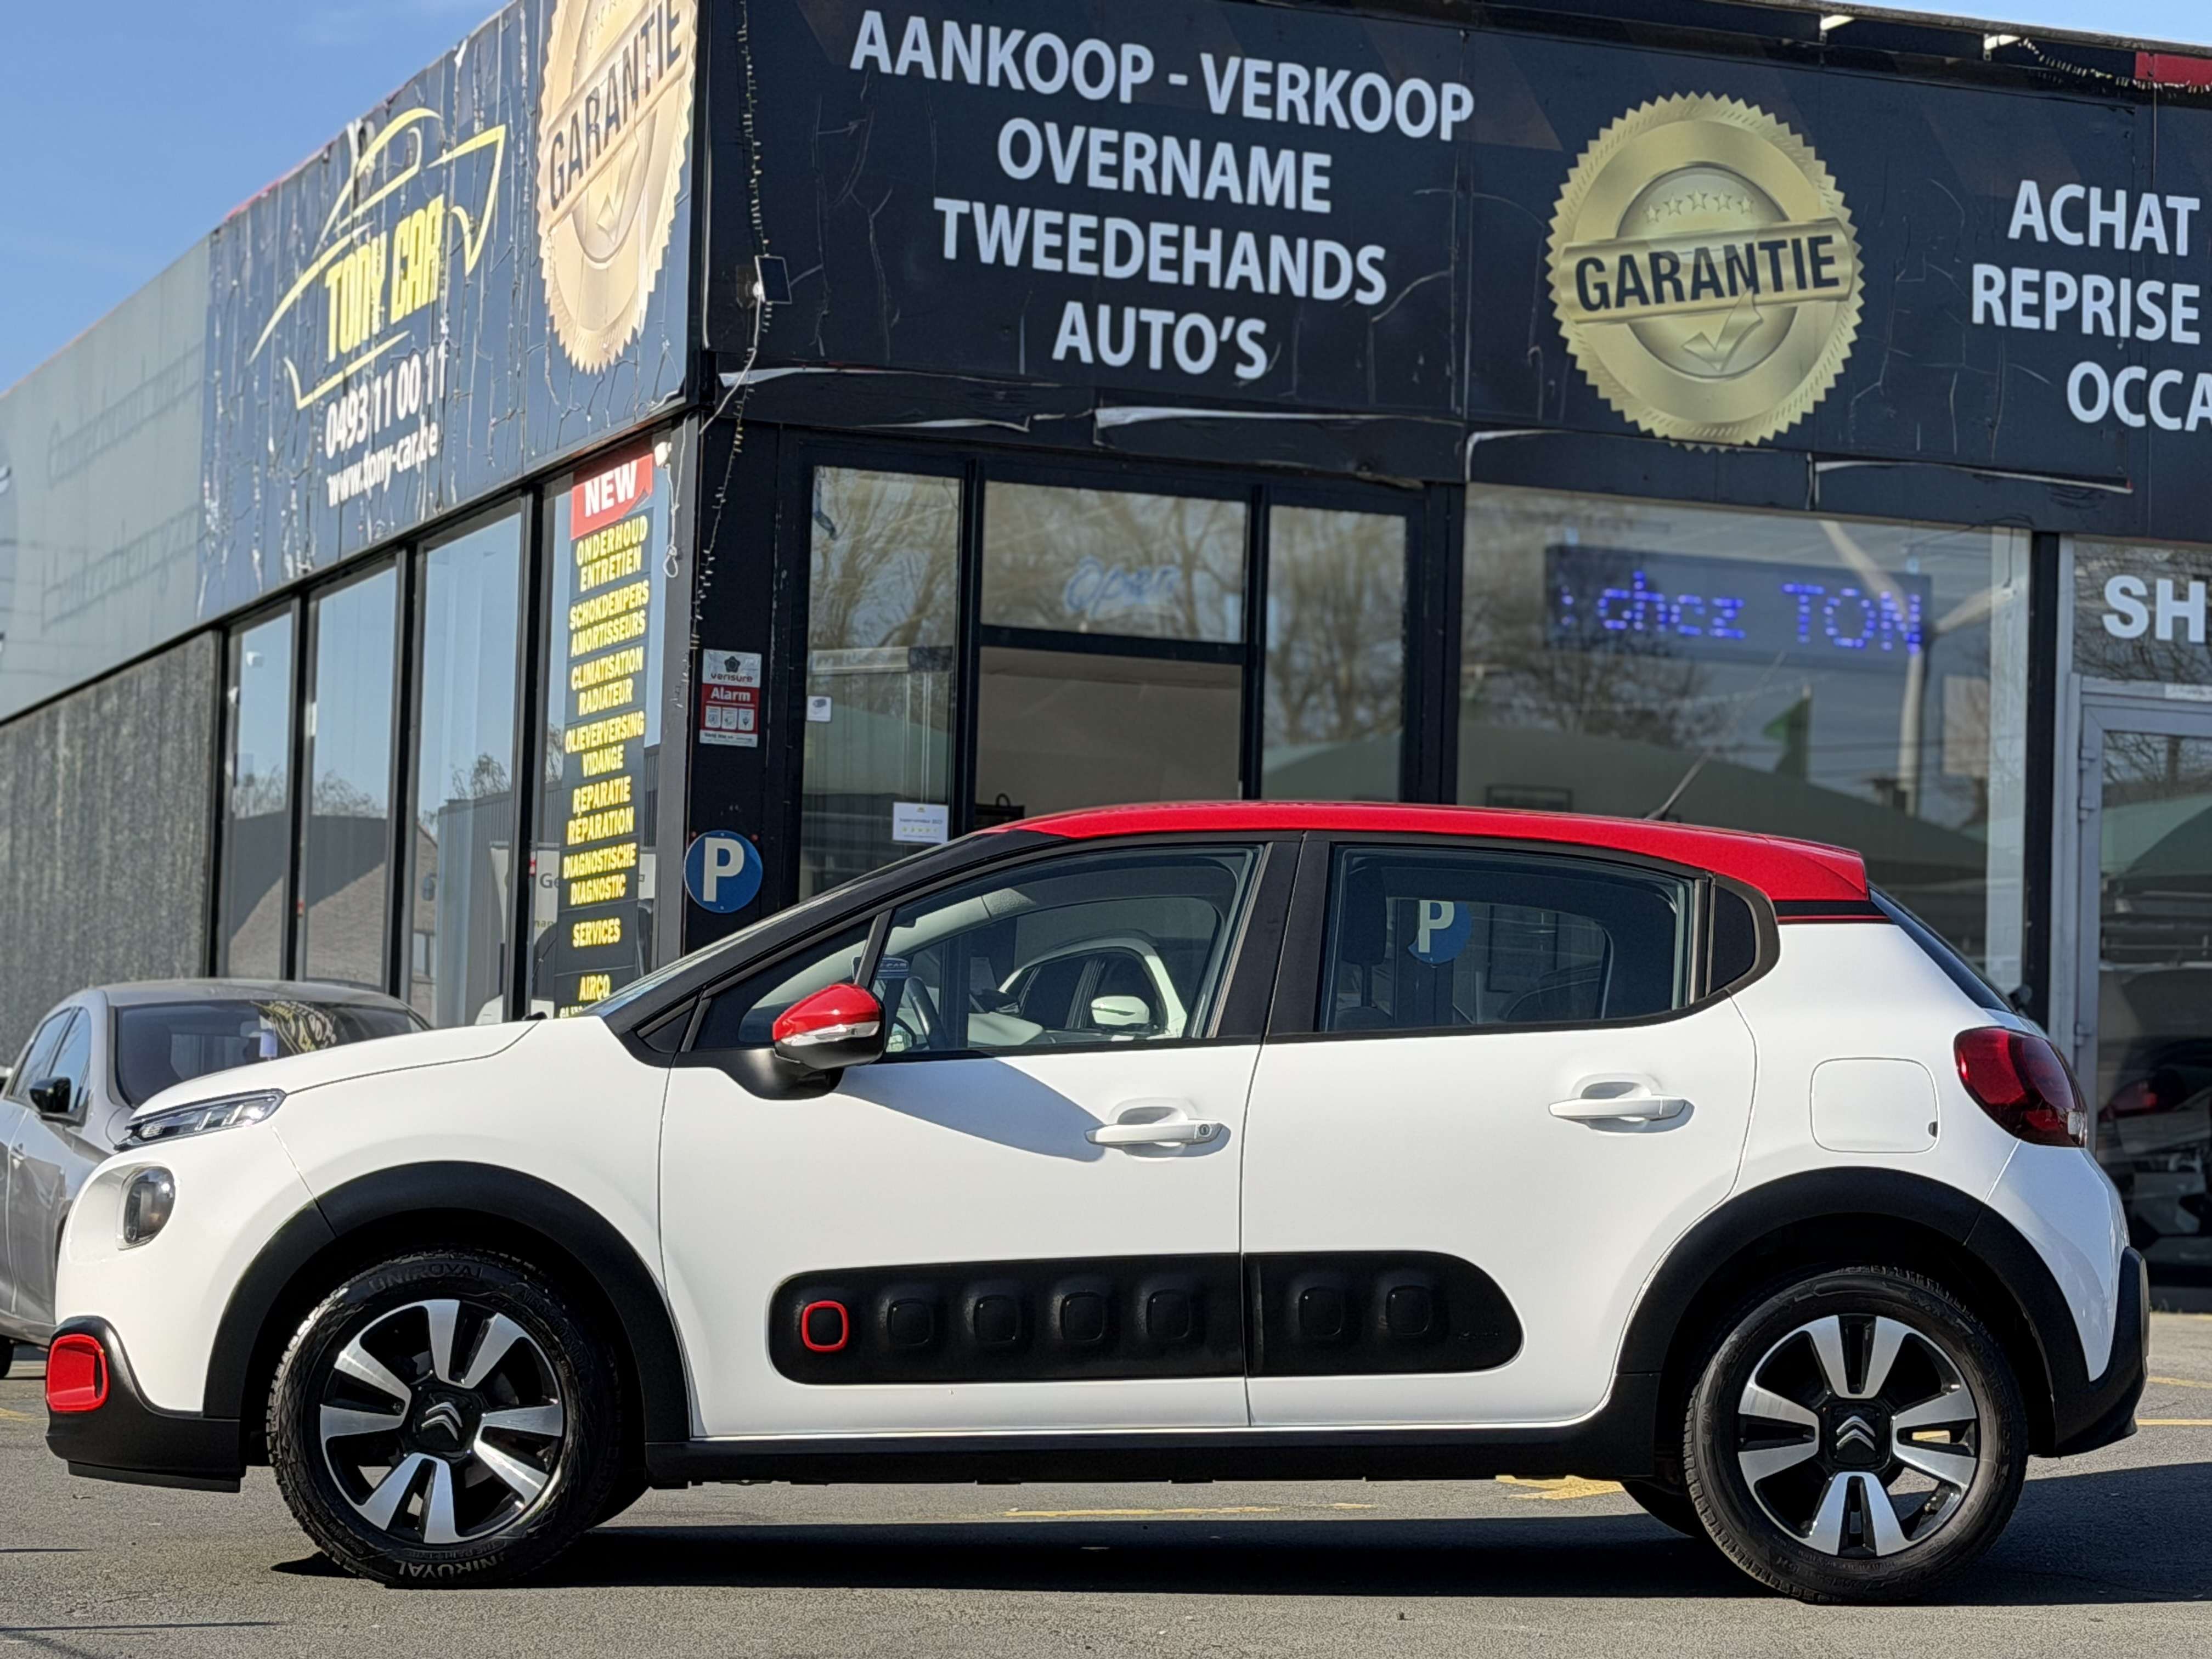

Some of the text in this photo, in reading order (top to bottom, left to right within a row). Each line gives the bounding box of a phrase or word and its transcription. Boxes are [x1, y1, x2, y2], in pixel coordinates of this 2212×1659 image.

[851, 10, 1474, 141] AANKOOP - VERKOOP
[550, 0, 682, 211] GARANTIE
[998, 118, 1331, 213] OVERNAME
[2007, 180, 2200, 257] ACHAT
[325, 194, 444, 363] TONY CAR
[934, 198, 1387, 305] TWEEDEHANDS
[1575, 235, 1839, 312] GARANTIE
[1973, 263, 2200, 345] REPRISE
[1052, 301, 1267, 379] AUTO'S
[326, 341, 447, 459] 0493 11 00 11
[2067, 361, 2212, 432] OCCA
[326, 415, 438, 507] www.tony-car.be
[584, 461, 637, 517] NEW
[577, 515, 648, 566] ONDERHOUD
[580, 545, 641, 592] ENTRETIEN
[569, 579, 649, 630] SCHOKDEMPERS
[1783, 583, 1920, 653] TON
[2102, 575, 2205, 644] SH
[571, 610, 646, 657] AMORTISSEURS
[571, 646, 644, 691] CLIMATISATION
[710, 673, 753, 683] verisure
[711, 687, 751, 702] Alarm
[579, 678, 633, 716] RADIATEUR
[565, 711, 645, 754] OLIEVERVERSING
[582, 744, 624, 777] VIDANGE
[573, 776, 631, 814] REPARATIE
[563, 843, 636, 879] DIAGNOSTISCHE
[703, 837, 744, 902] P
[570, 874, 626, 905] DIAGNOSTIC
[573, 918, 620, 947] SERVICES
[1418, 900, 1454, 953] P
[579, 974, 611, 1001] AIRCO
